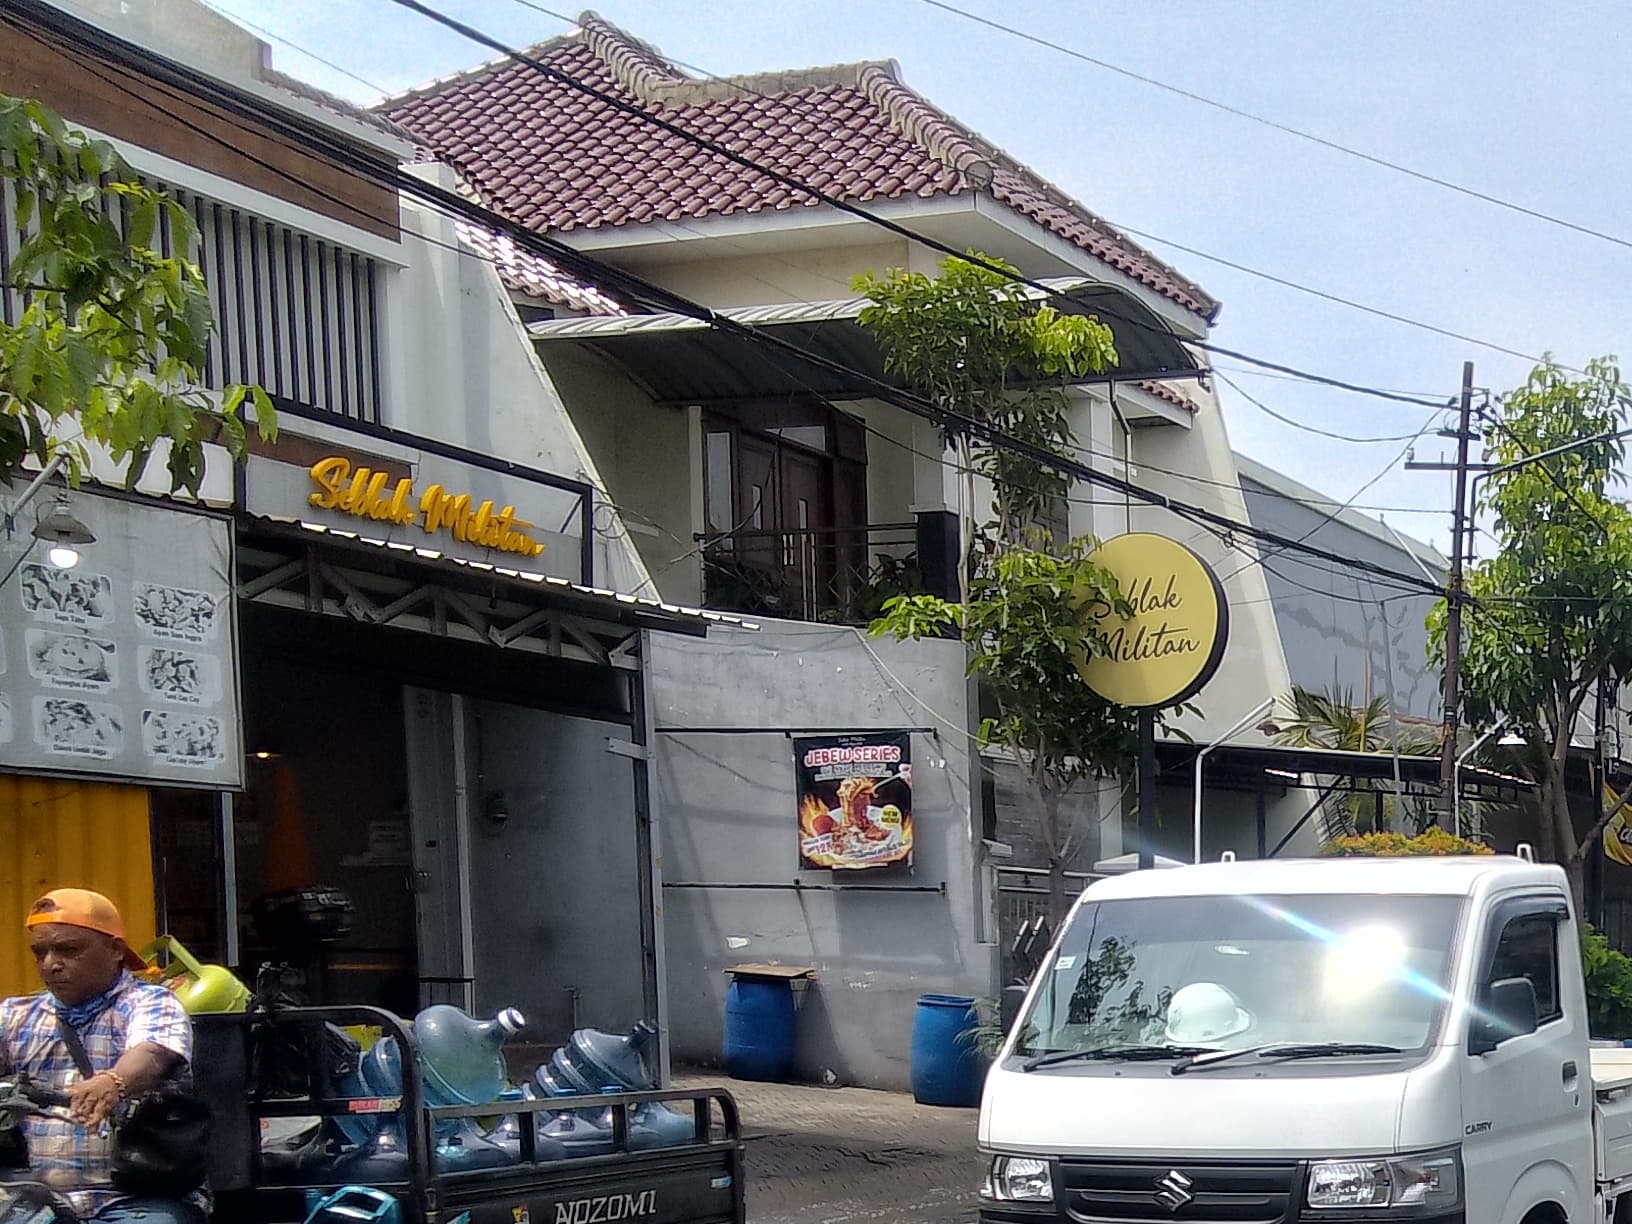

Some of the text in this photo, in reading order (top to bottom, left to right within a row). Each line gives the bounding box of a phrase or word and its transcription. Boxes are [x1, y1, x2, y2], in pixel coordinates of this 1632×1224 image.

[309, 456, 546, 557] Seblak Militan
[1080, 574, 1182, 618] Sblak
[805, 746, 900, 766] JEBEW SERIES
